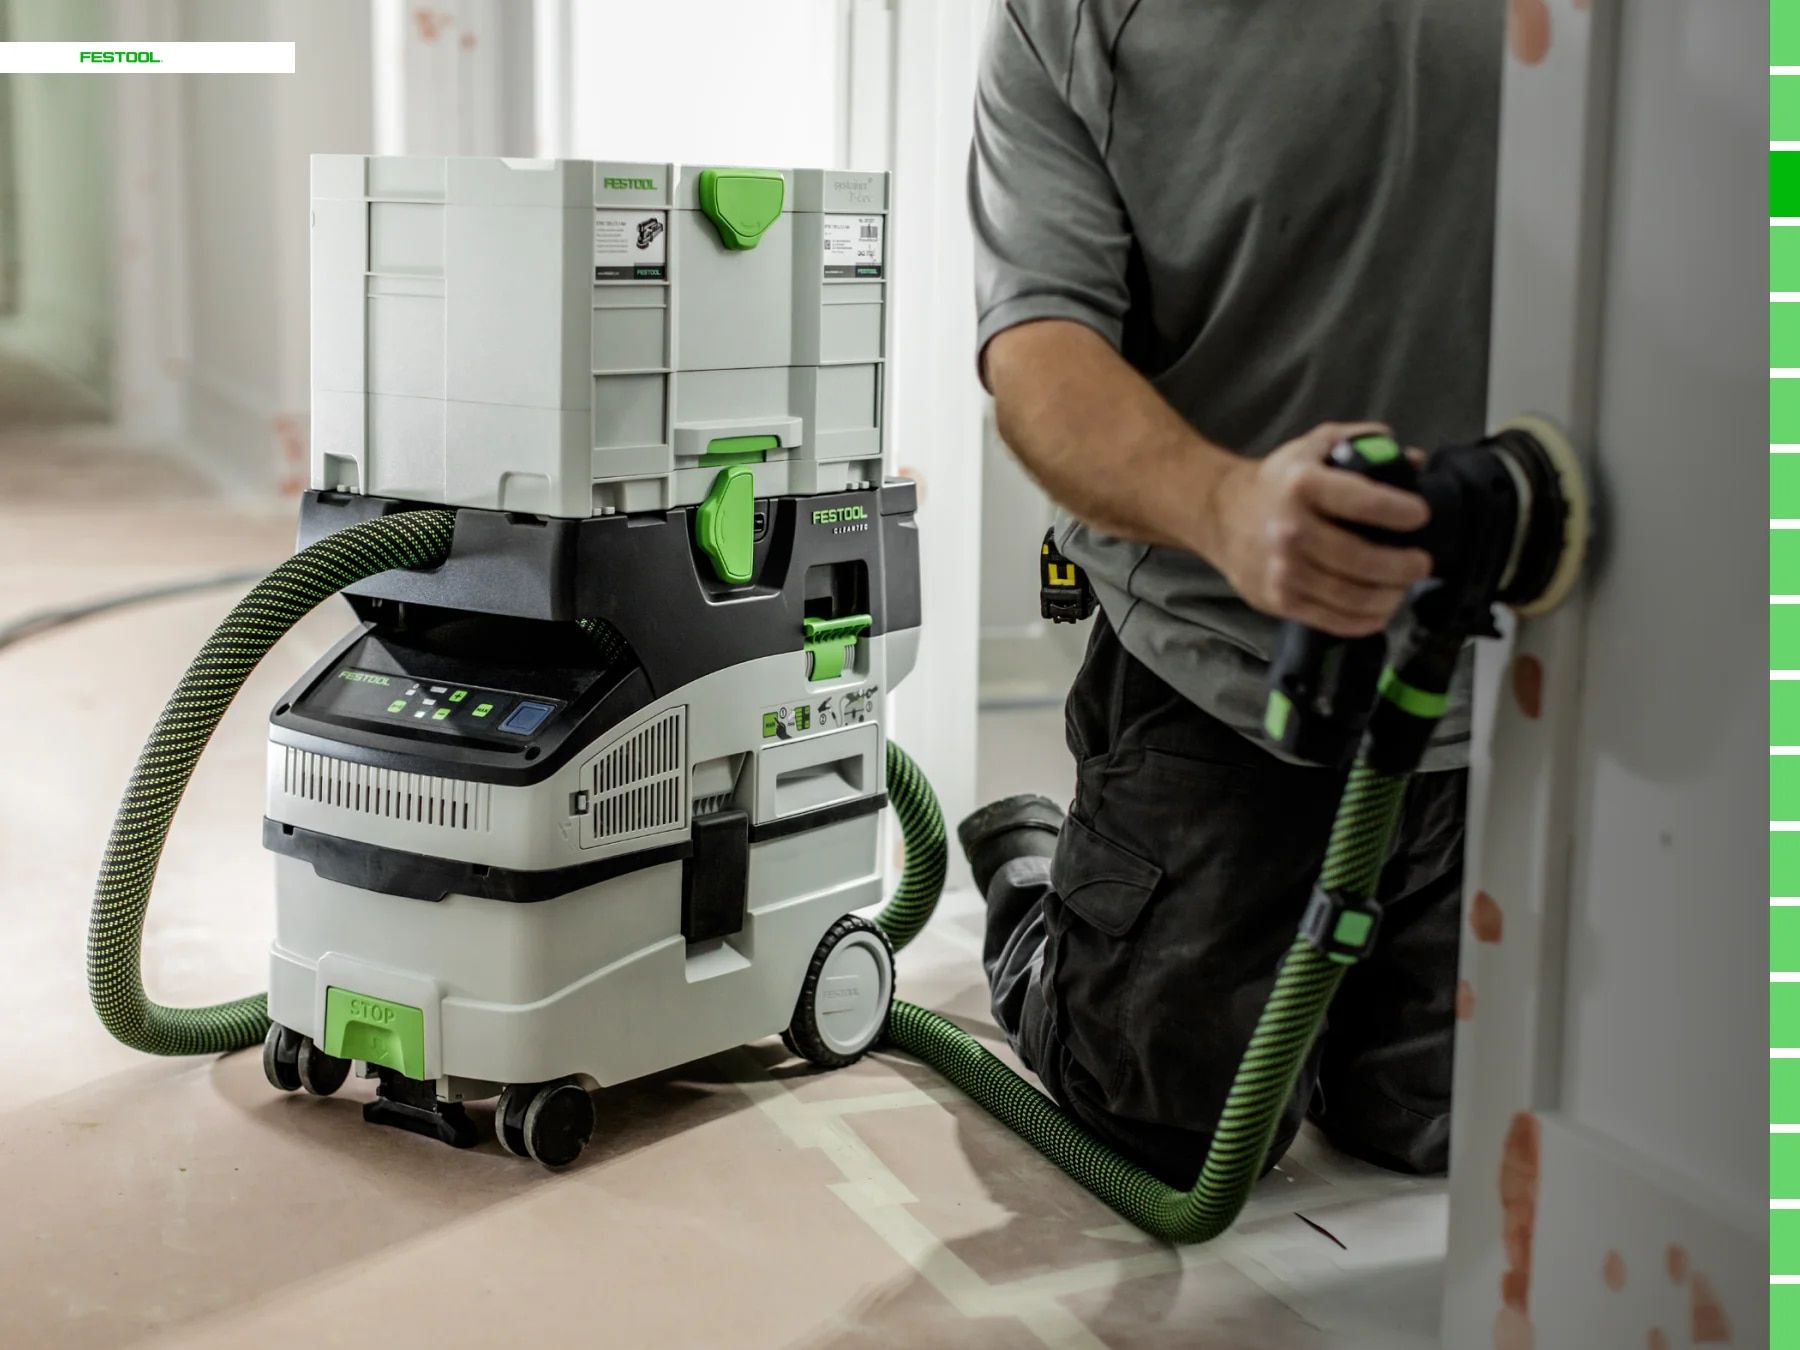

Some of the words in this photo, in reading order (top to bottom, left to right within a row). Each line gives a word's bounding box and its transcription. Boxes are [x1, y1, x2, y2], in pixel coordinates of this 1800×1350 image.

[603, 177, 658, 190] FESTOOL
[812, 505, 868, 525] FESTOOL
[338, 671, 390, 686] FESTOOL
[350, 999, 395, 1025] STOP
